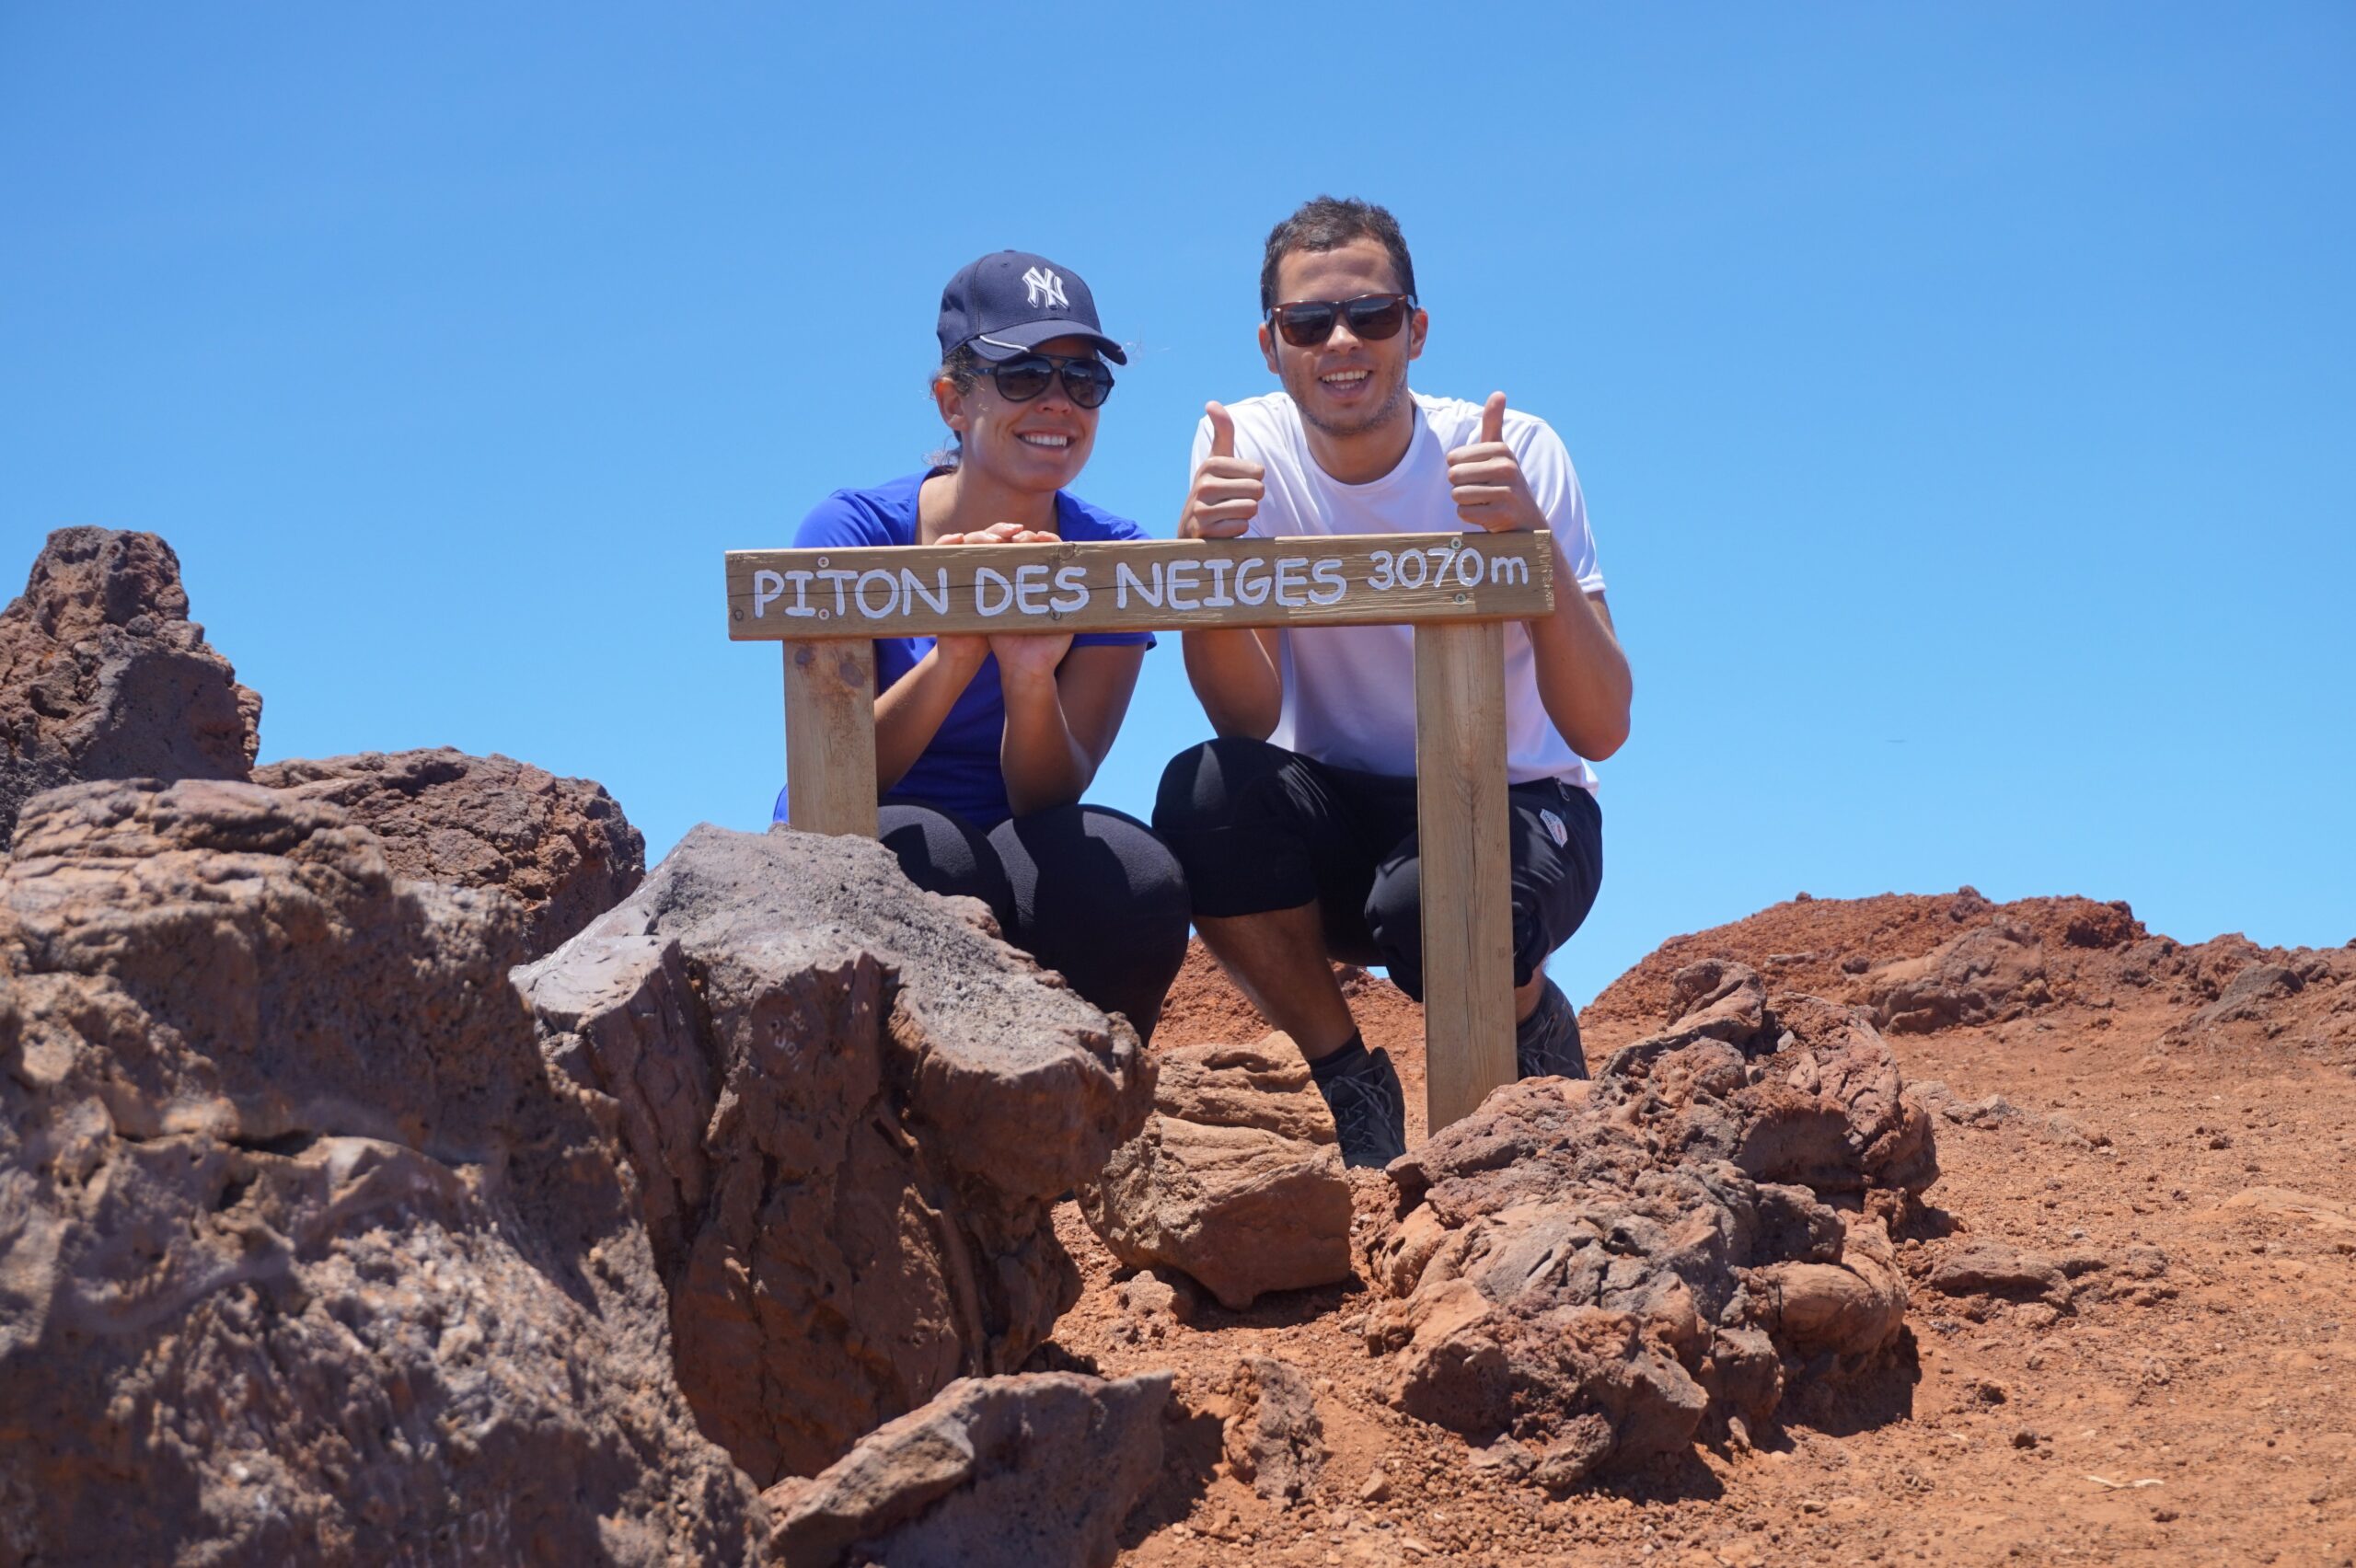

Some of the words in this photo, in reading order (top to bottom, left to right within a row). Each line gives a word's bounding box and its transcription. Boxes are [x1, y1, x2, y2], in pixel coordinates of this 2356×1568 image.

[754, 567, 949, 619] PITON
[976, 565, 1091, 617] DES
[1115, 557, 1347, 609] NEIGES
